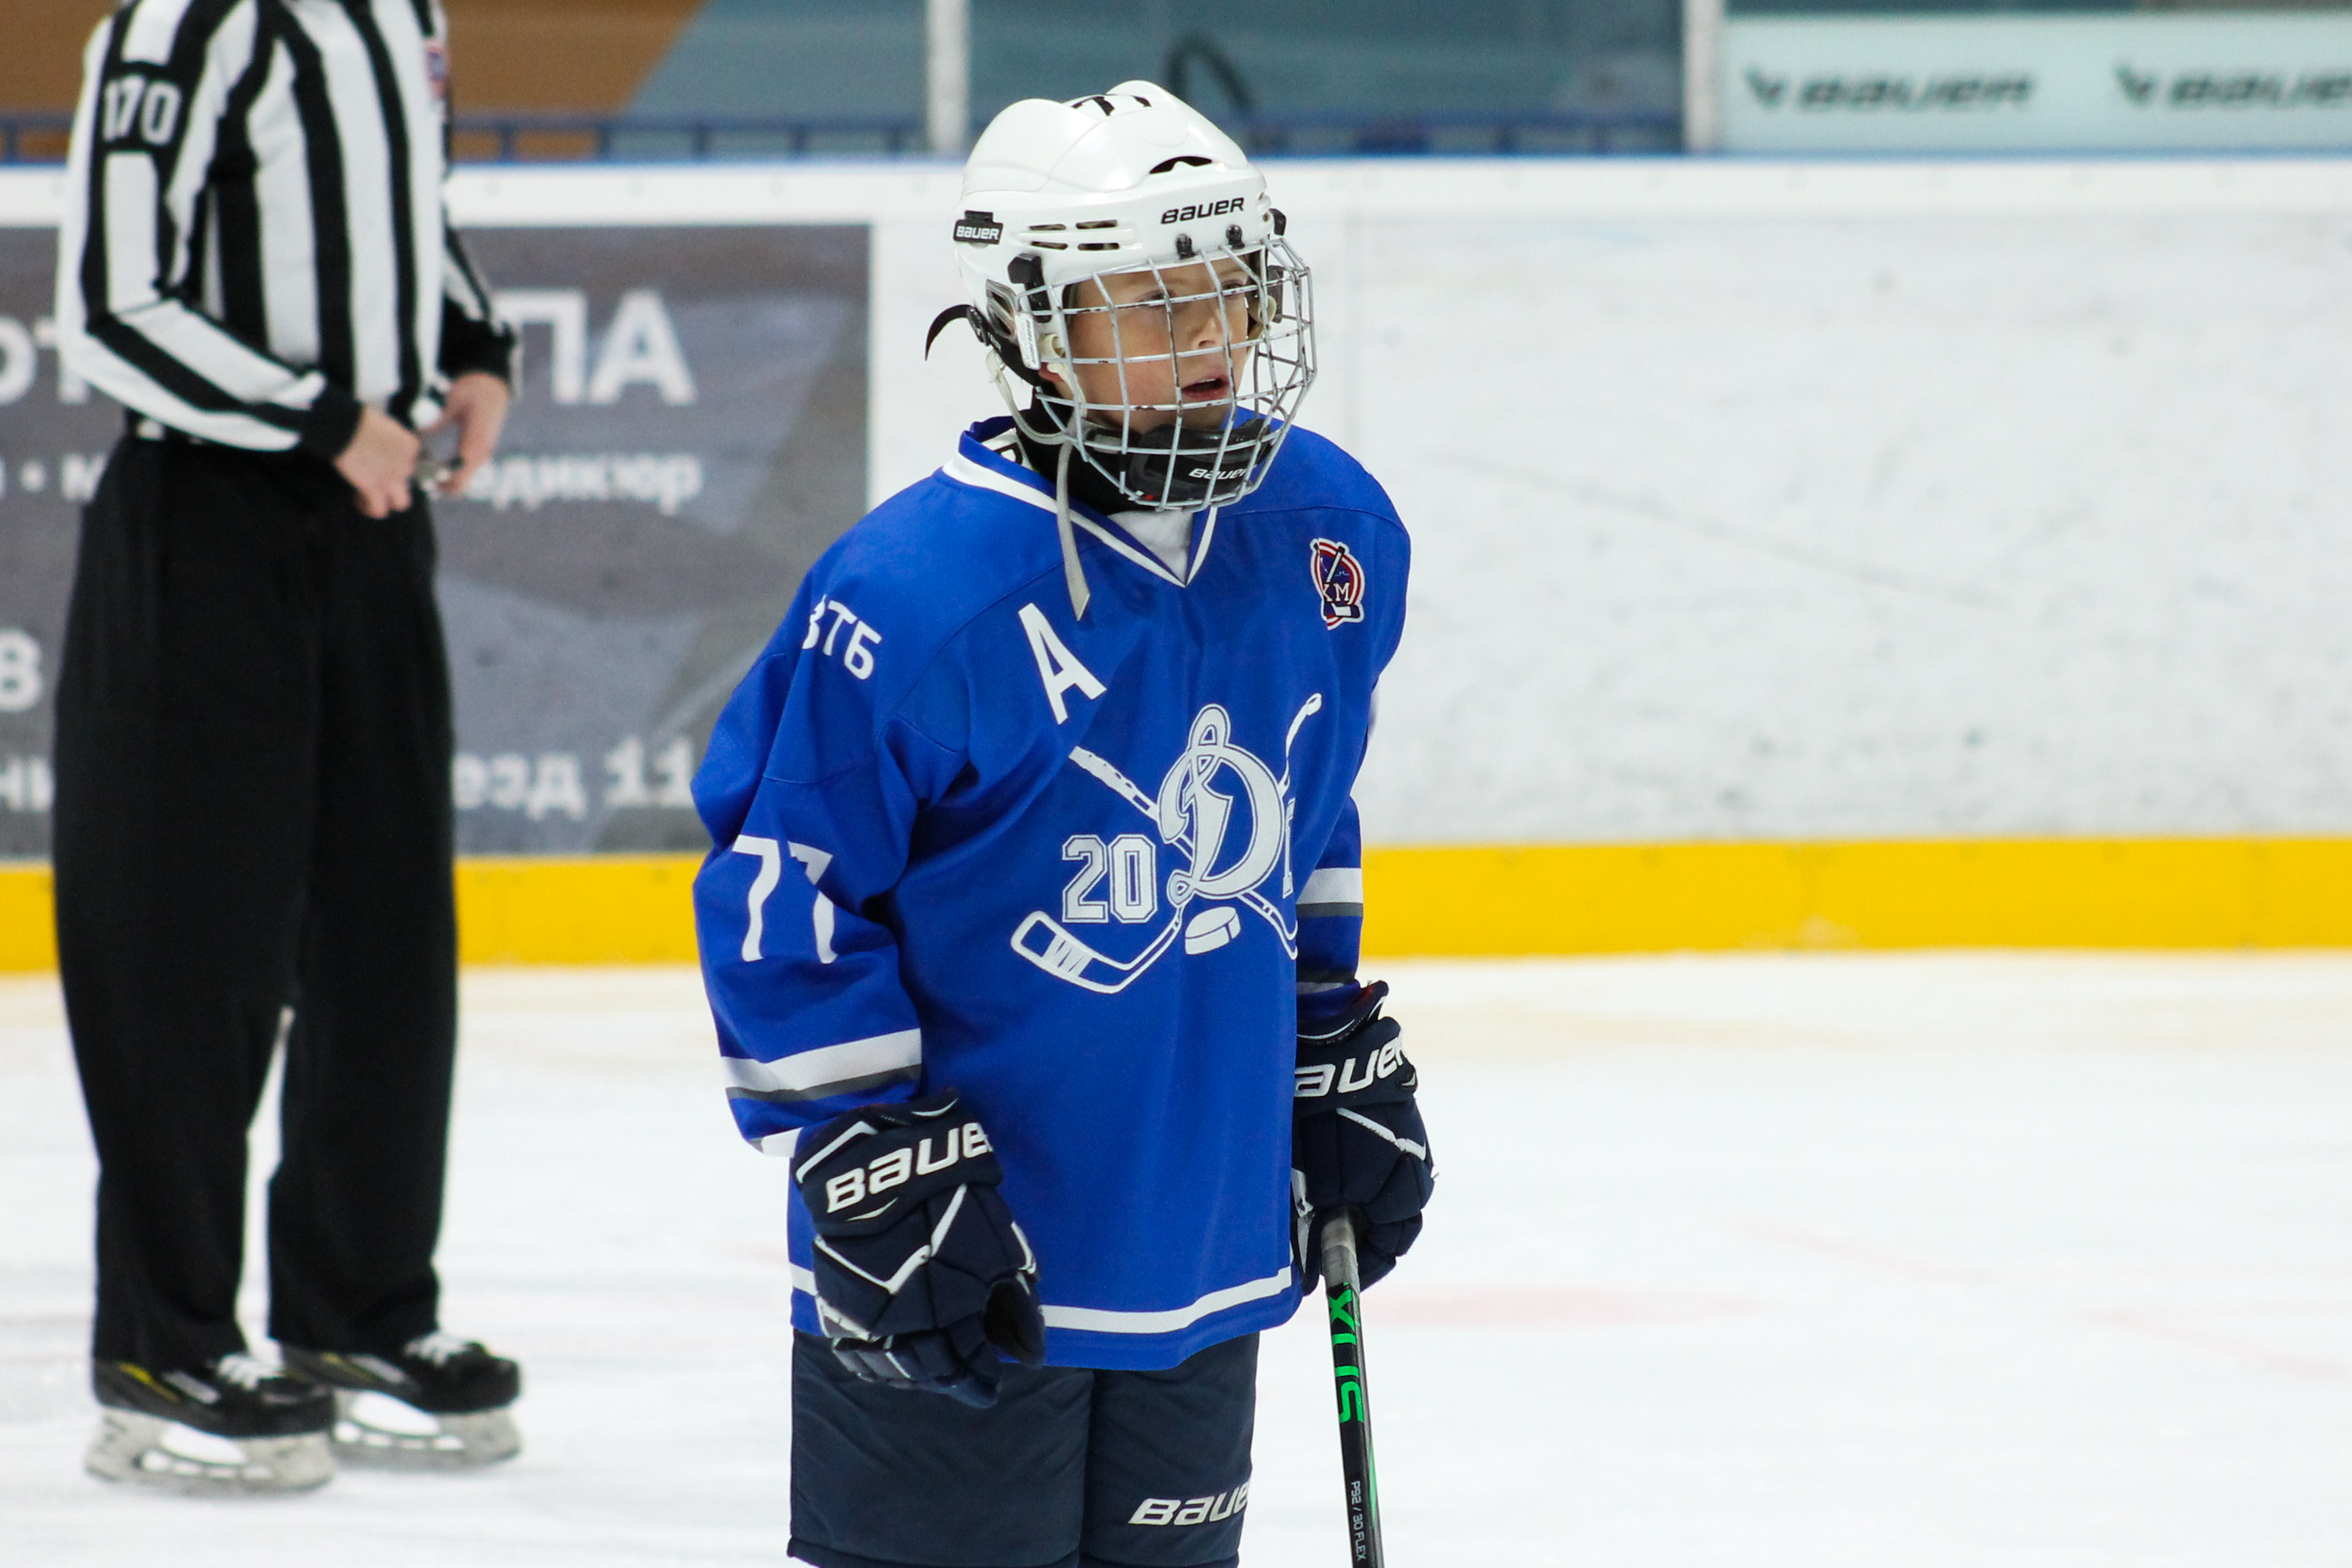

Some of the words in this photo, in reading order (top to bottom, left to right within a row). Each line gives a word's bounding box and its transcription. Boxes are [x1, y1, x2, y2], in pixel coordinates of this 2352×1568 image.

[104, 74, 181, 145] 170
[956, 225, 999, 241] BAUER
[1160, 197, 1244, 224] BAUER
[466, 452, 702, 516] едикюр
[1018, 603, 1106, 724] A
[452, 752, 586, 821] езд
[826, 1122, 993, 1213] BAUE
[1128, 1481, 1250, 1526] BAUE
[1351, 1480, 1362, 1505] P92
[1353, 1513, 1364, 1530] 30
[1355, 1531, 1367, 1561] FLEX
